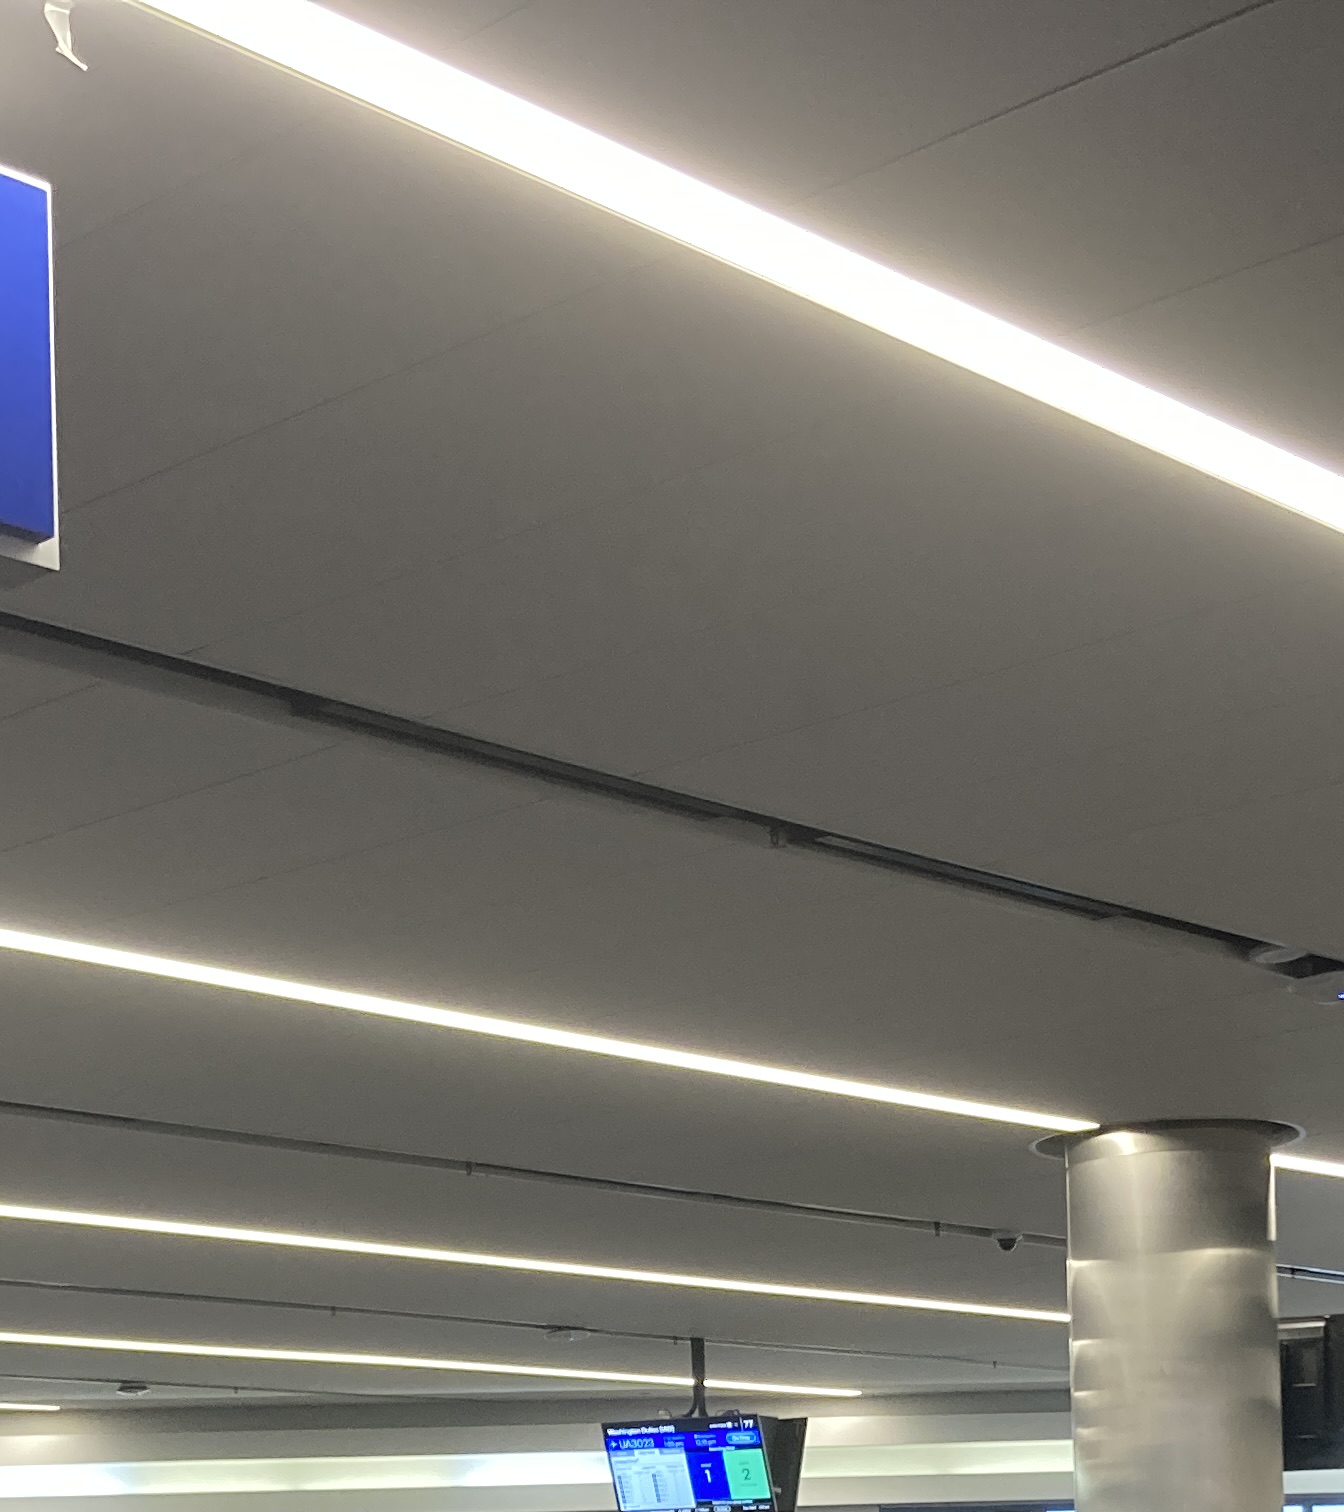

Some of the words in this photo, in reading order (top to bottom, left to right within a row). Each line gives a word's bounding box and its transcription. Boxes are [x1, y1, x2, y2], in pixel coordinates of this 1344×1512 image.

[743, 1419, 753, 1428] 77
[704, 1469, 712, 1483] 1
[742, 1468, 751, 1481] 2
